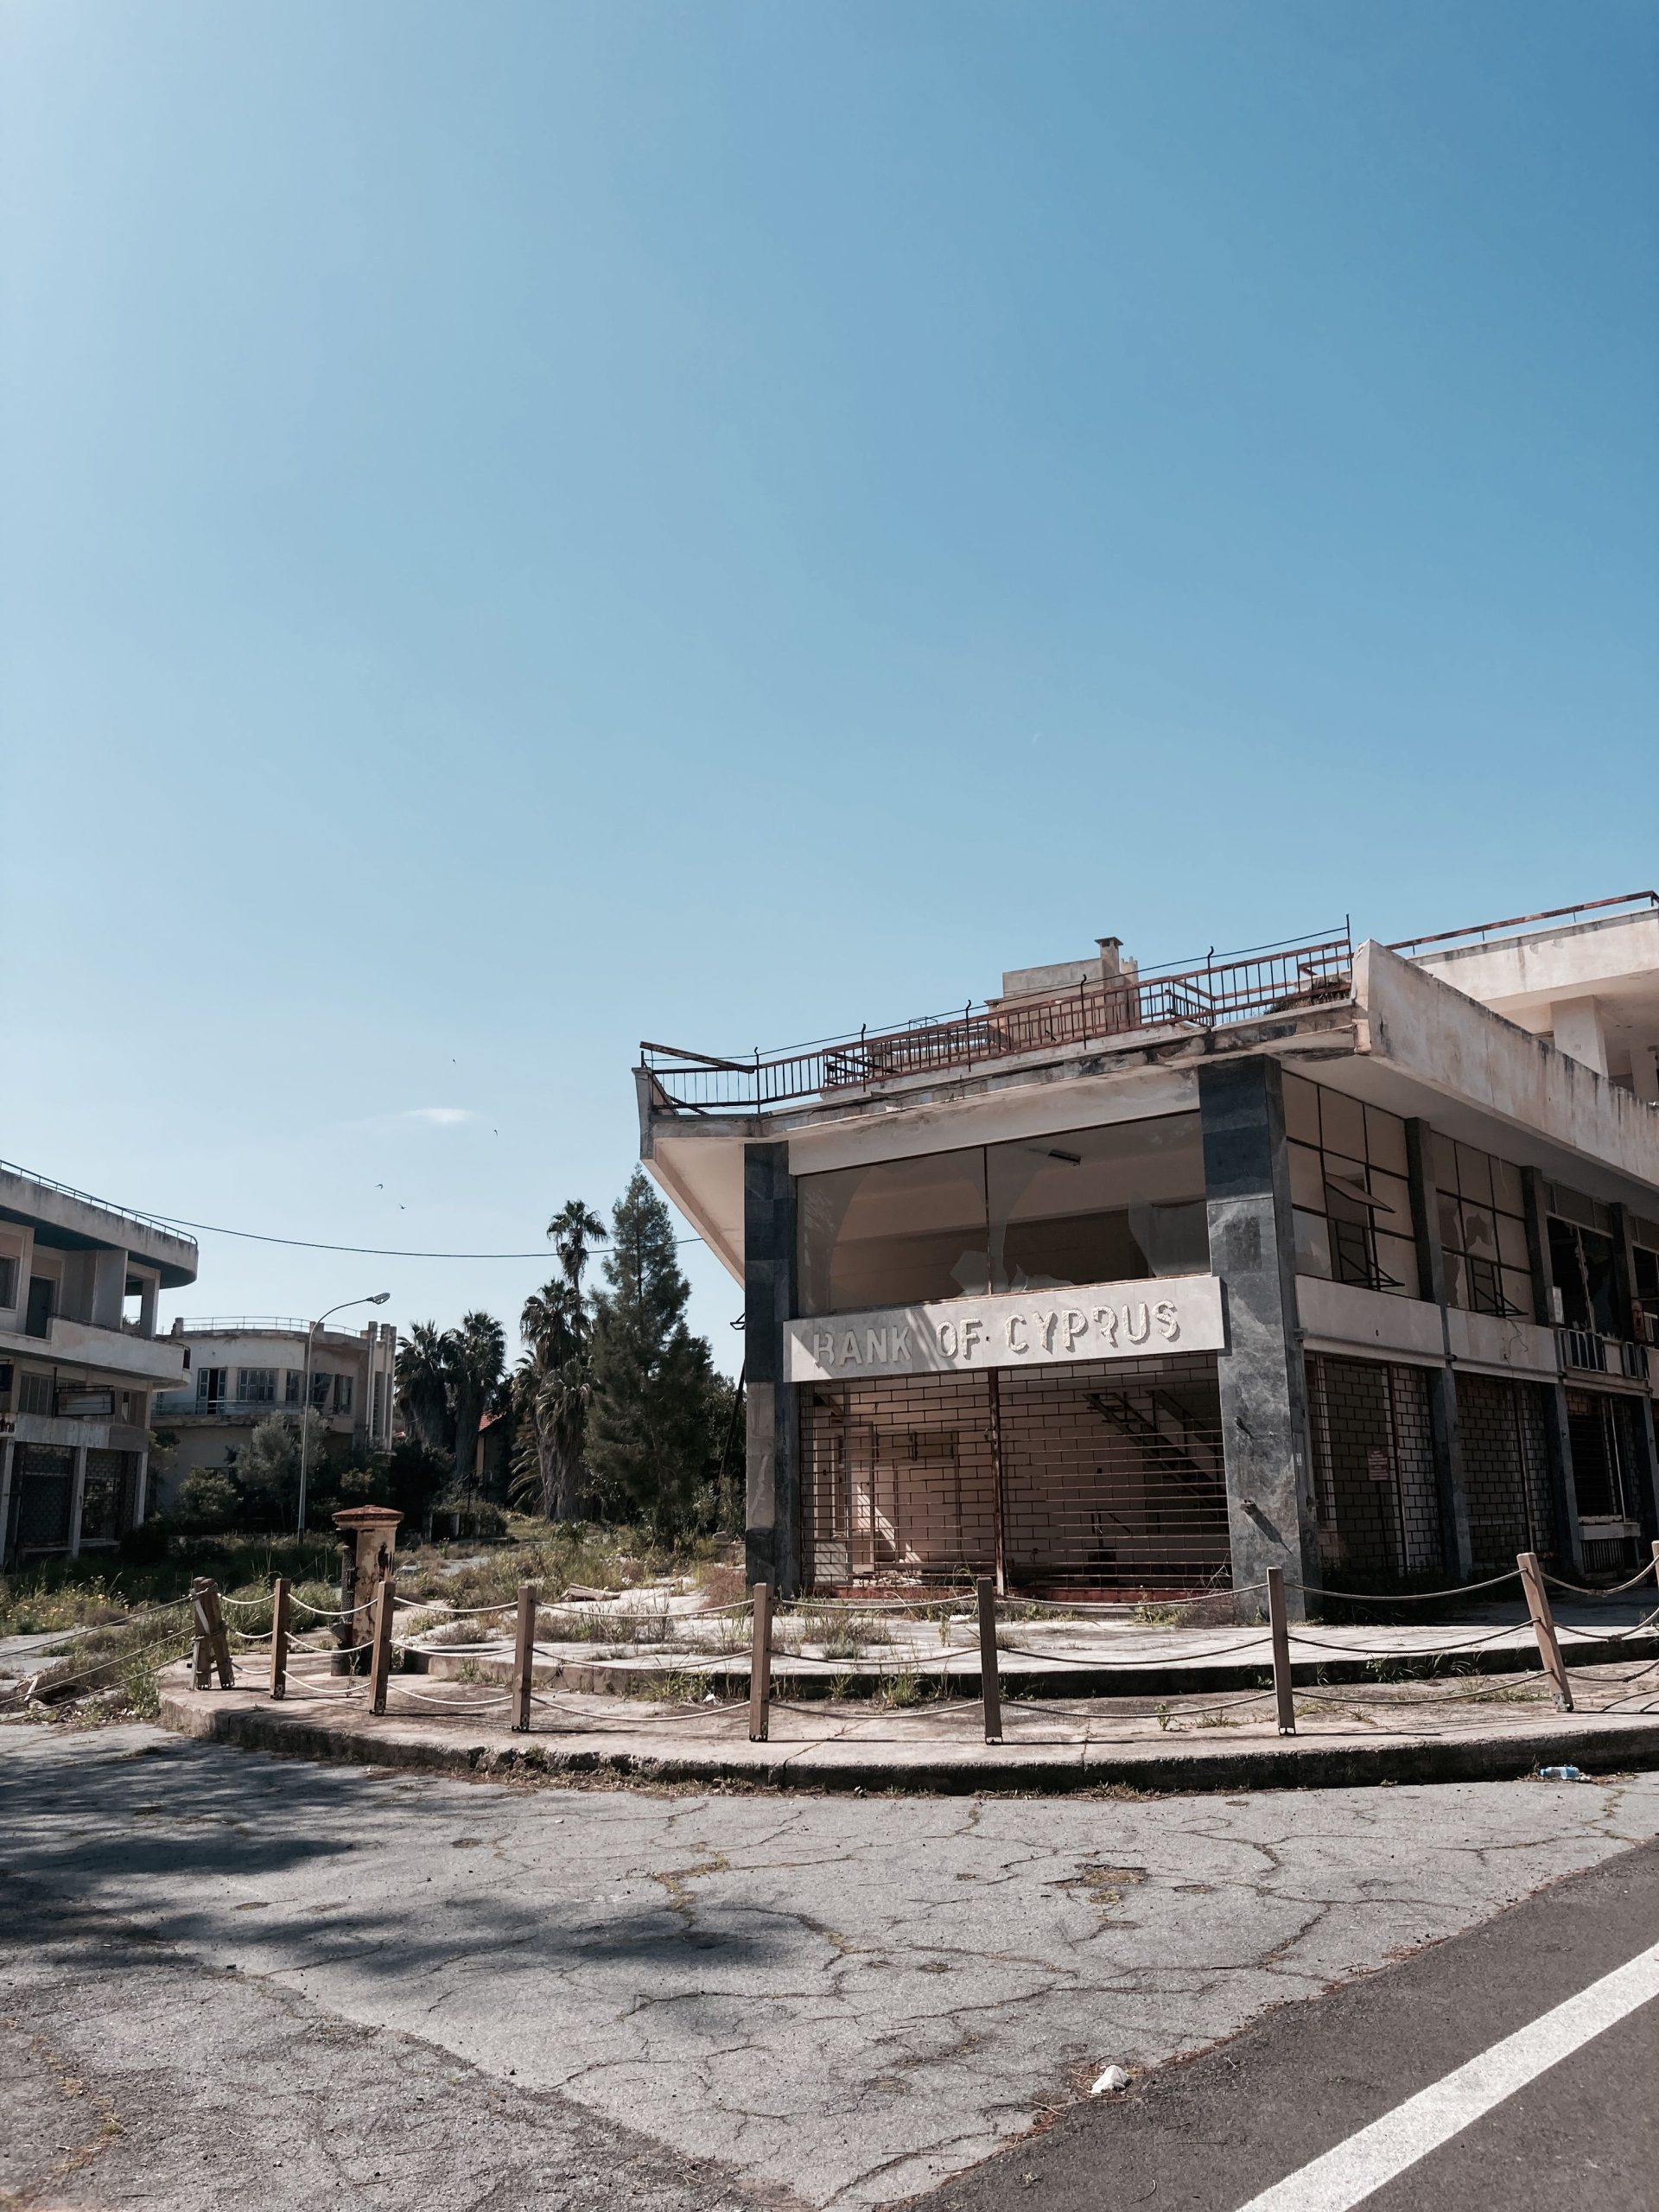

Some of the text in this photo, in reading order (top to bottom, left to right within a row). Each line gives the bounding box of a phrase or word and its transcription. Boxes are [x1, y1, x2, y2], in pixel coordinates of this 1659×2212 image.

[813, 1300, 1178, 1366] BANK OF CYPRUS
